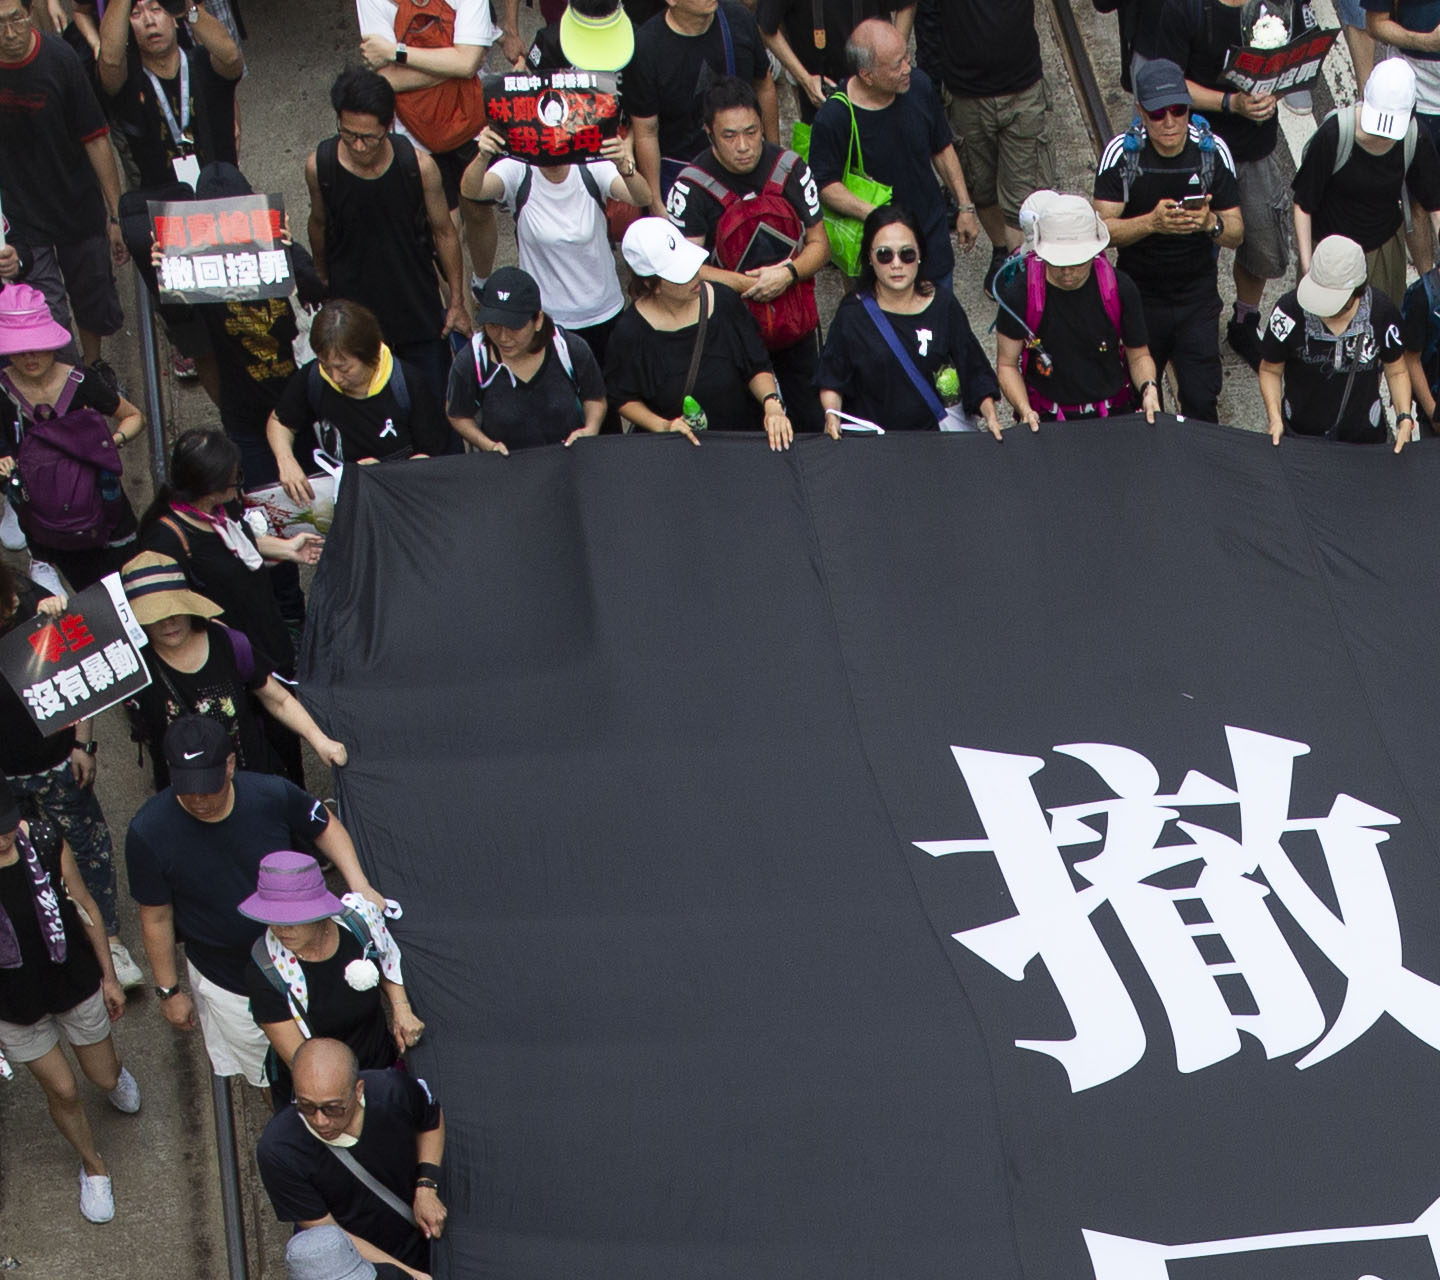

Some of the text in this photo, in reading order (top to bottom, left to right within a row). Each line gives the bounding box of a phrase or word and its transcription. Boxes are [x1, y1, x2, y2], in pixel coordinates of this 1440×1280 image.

[162, 249, 291, 292] 撤回控罪
[22, 644, 142, 723] 沒有暴動
